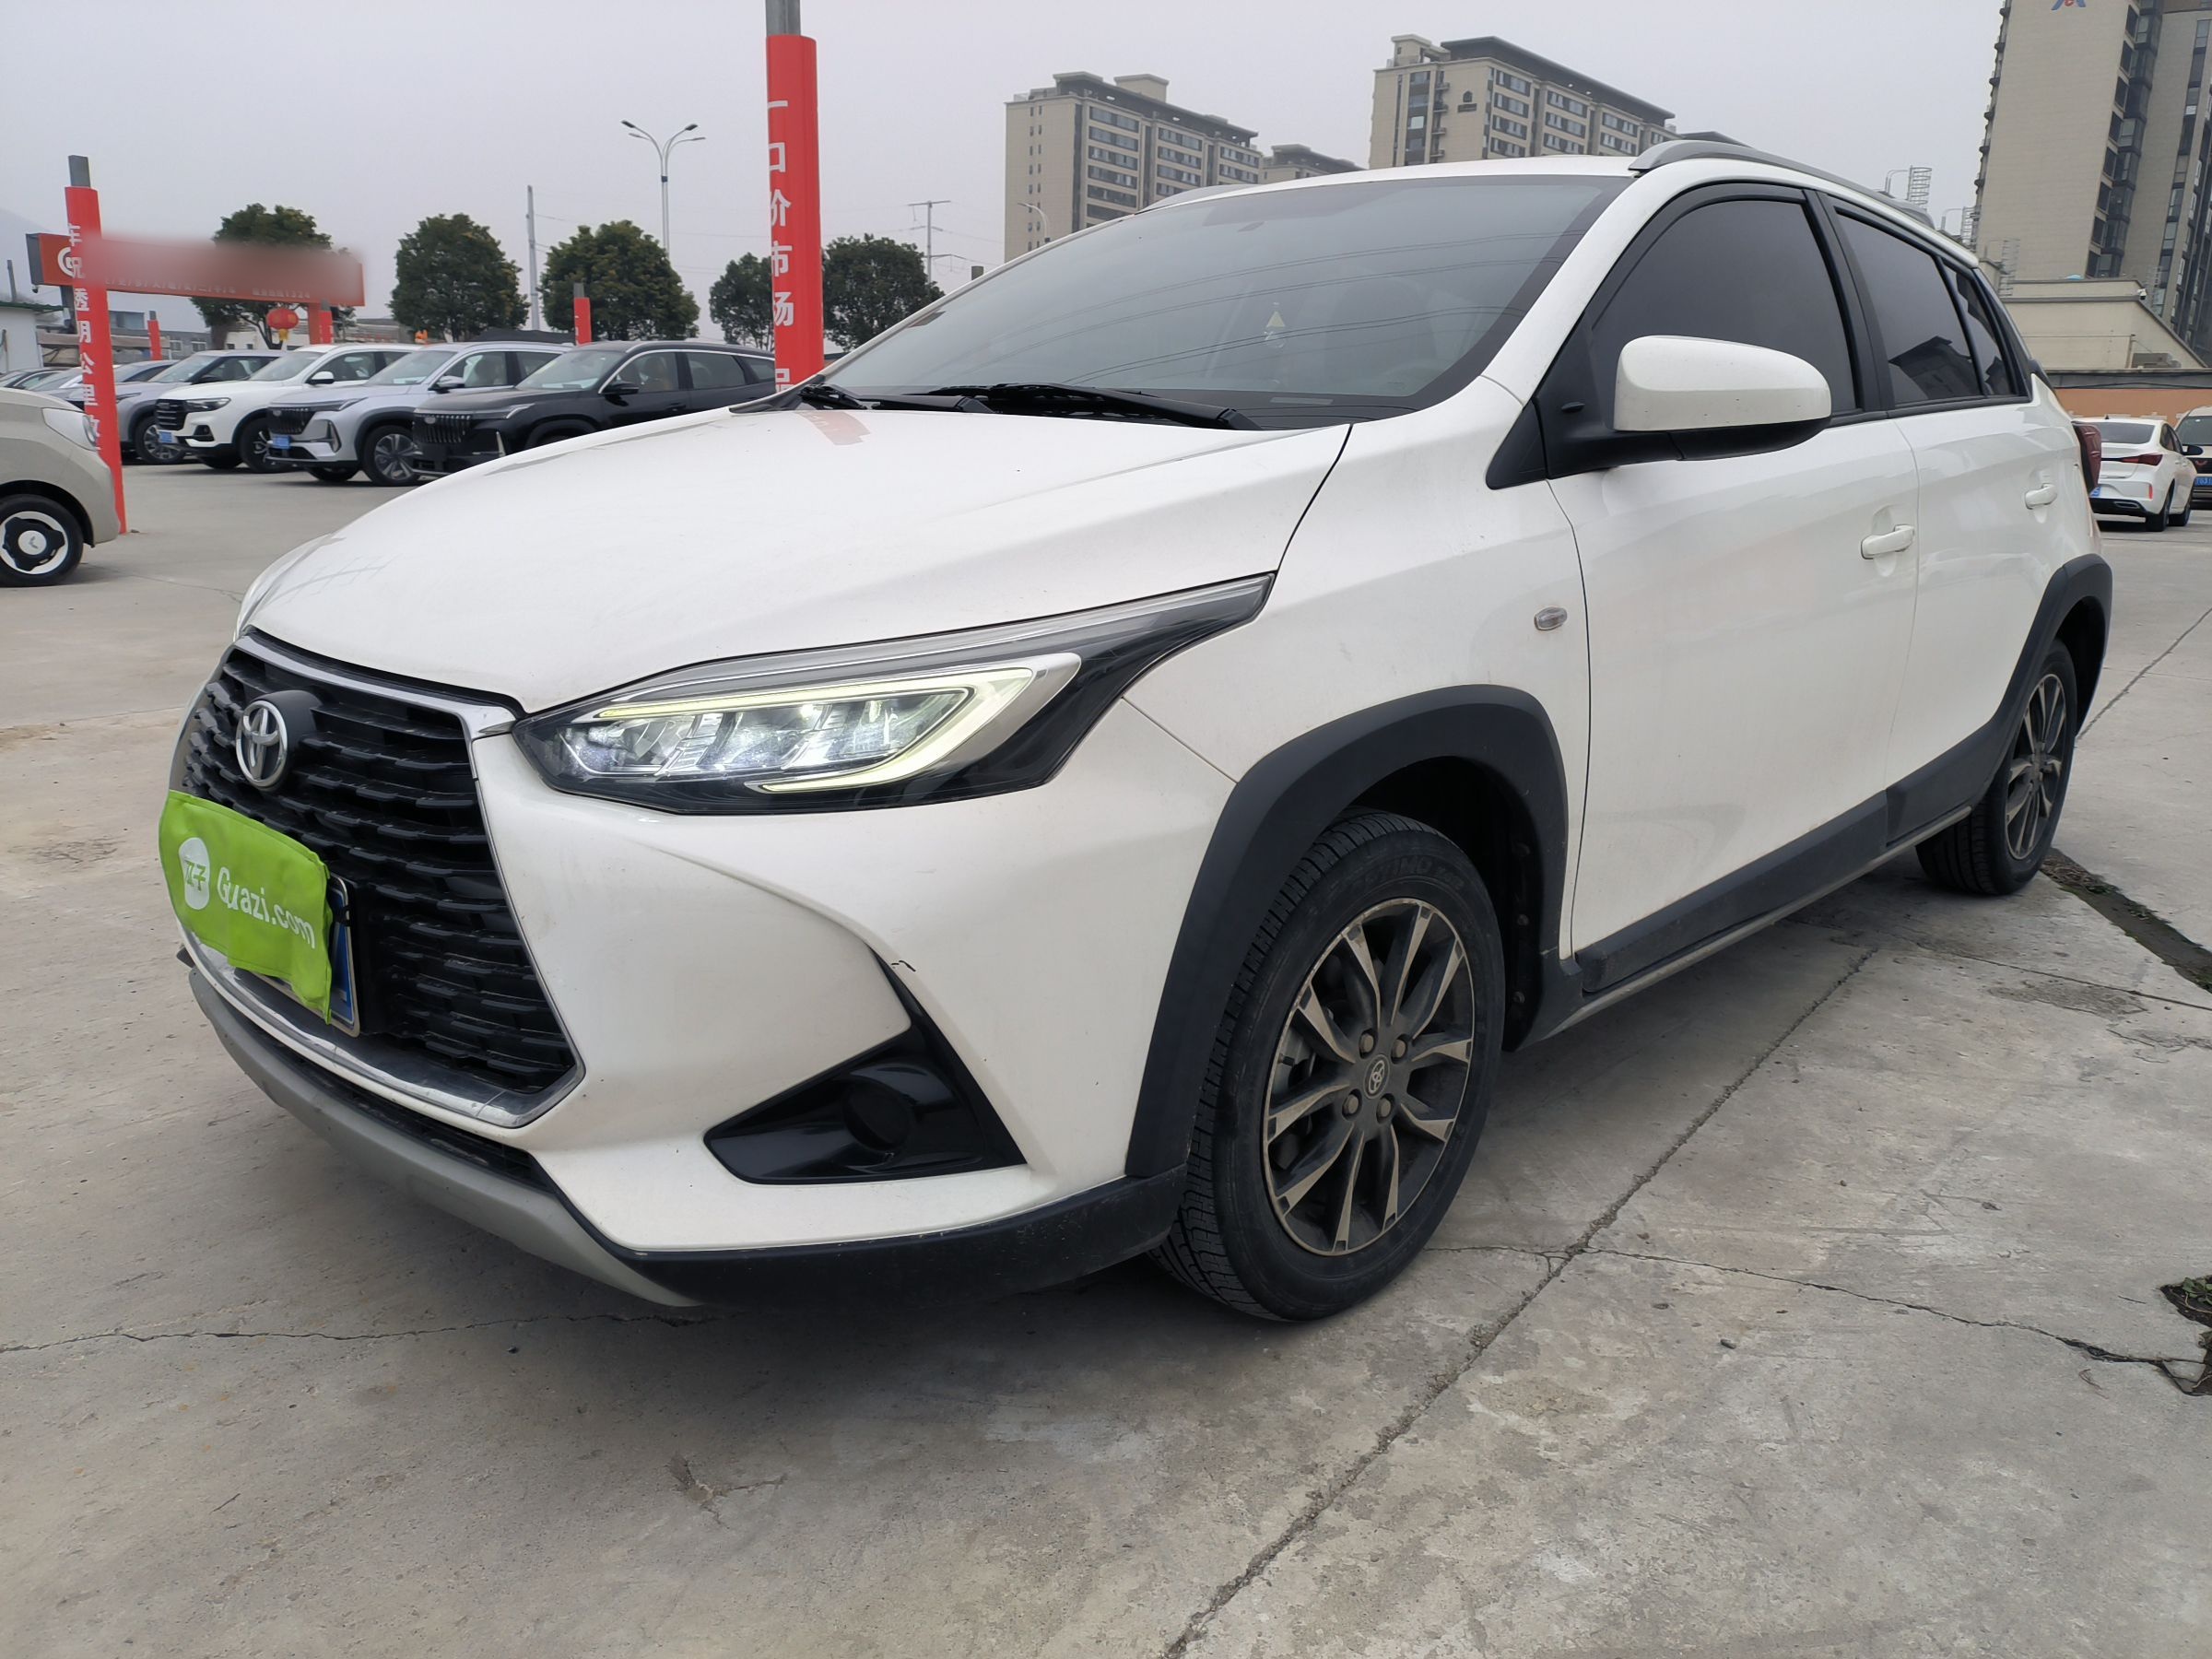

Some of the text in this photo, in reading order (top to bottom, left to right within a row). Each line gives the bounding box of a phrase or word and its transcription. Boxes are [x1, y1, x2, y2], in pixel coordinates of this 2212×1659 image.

[767, 100, 794, 326] 一口价市场
[217, 866, 315, 949] Guazi.com
